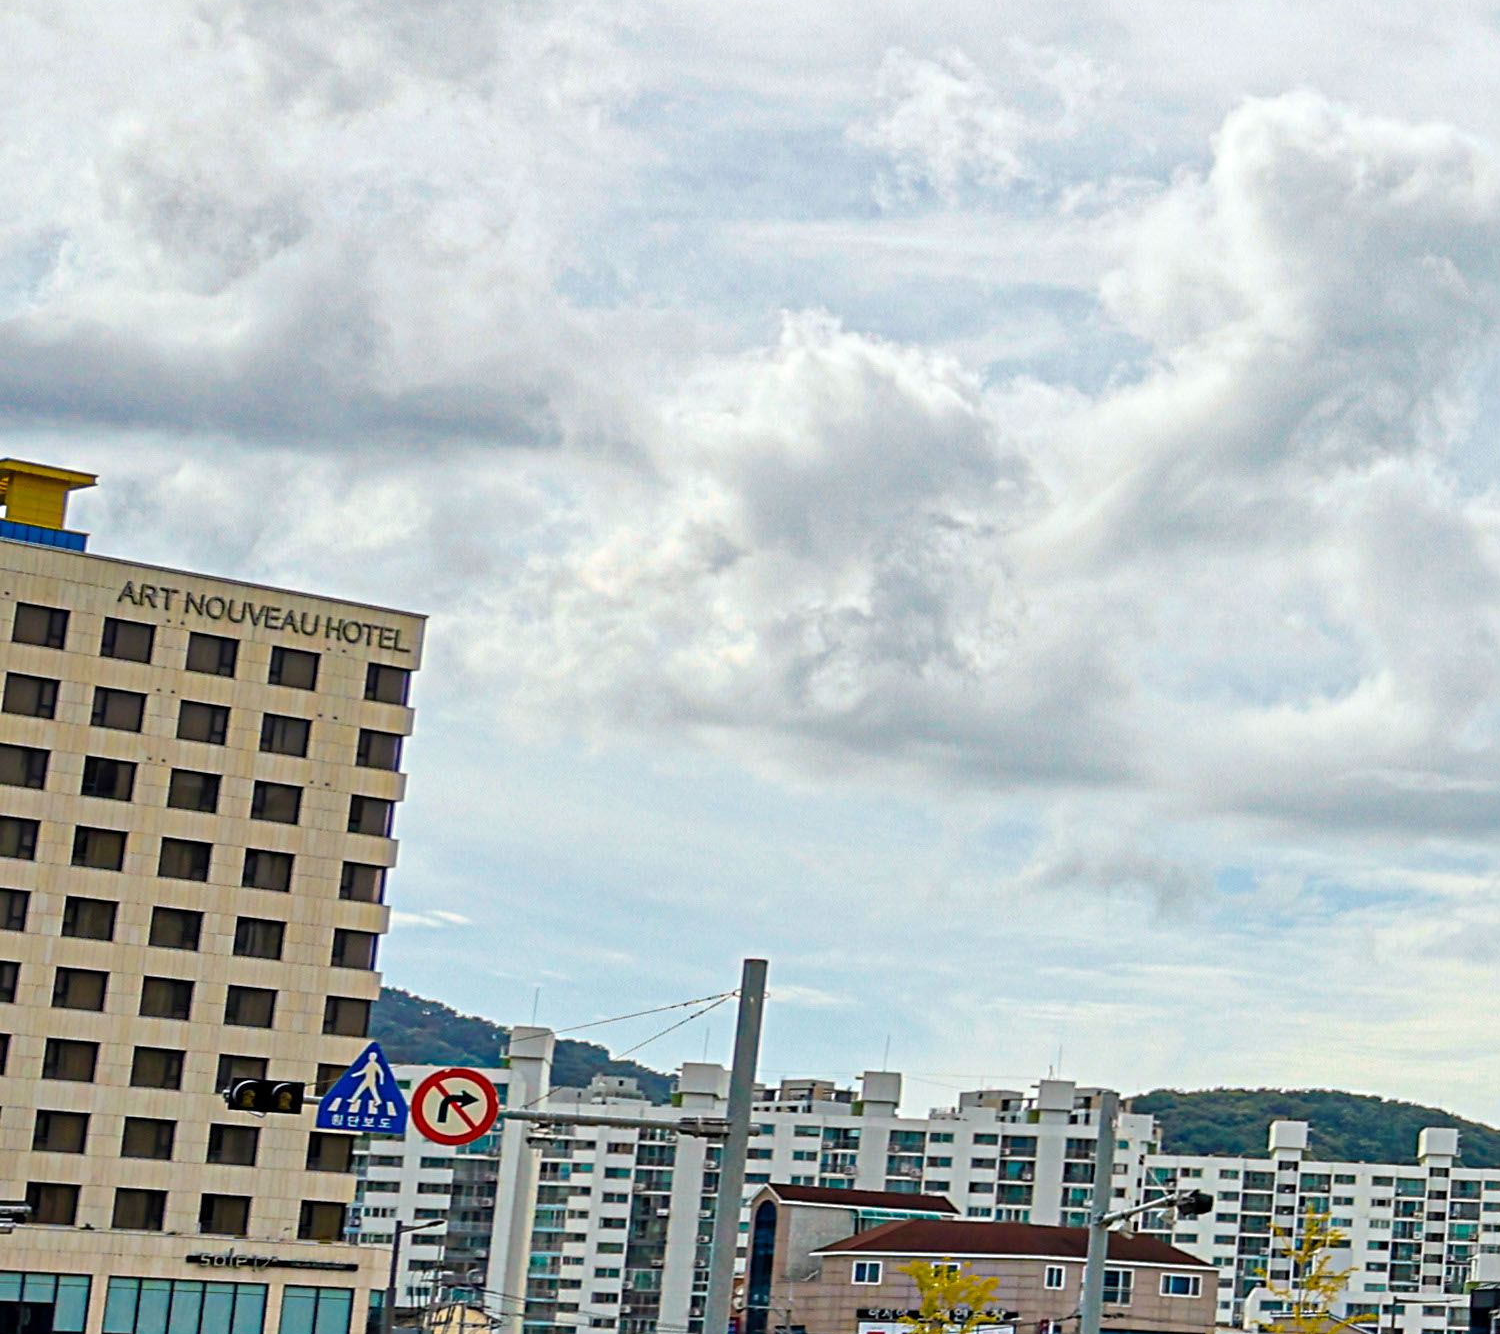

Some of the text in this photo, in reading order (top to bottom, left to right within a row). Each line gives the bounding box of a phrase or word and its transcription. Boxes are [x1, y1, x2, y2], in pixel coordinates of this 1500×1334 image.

[117, 581, 411, 654] ART NOUVEAU HOTEL
